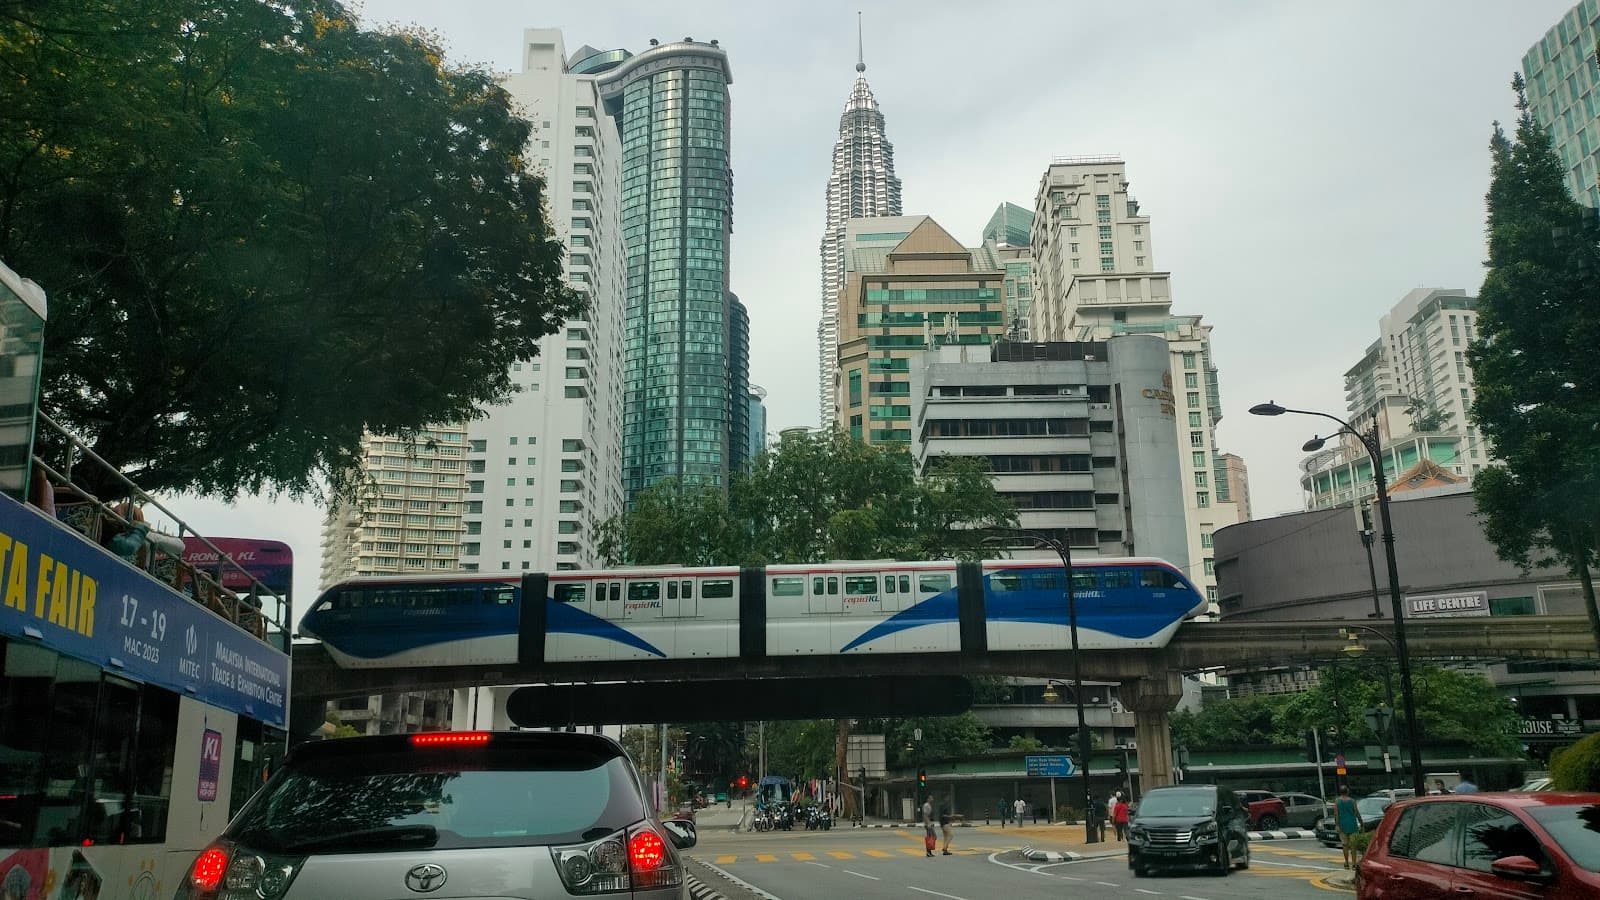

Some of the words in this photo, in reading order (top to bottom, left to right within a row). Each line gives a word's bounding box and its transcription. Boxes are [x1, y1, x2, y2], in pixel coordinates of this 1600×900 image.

[237, 551, 256, 560] KL
[35, 553, 97, 638] FAIR
[1413, 599, 1435, 612] LIFE
[1439, 596, 1481, 610] CENTRE
[121, 594, 138, 628] 17
[151, 609, 166, 642] 19
[124, 635, 142, 657] MAC
[142, 644, 160, 664] 2023
[215, 641, 243, 671] MALAYSIA
[179, 657, 200, 679] MITEC
[211, 662, 230, 687] TRADE
[237, 674, 265, 702] EXHIBITION
[204, 737, 220, 761] KL
